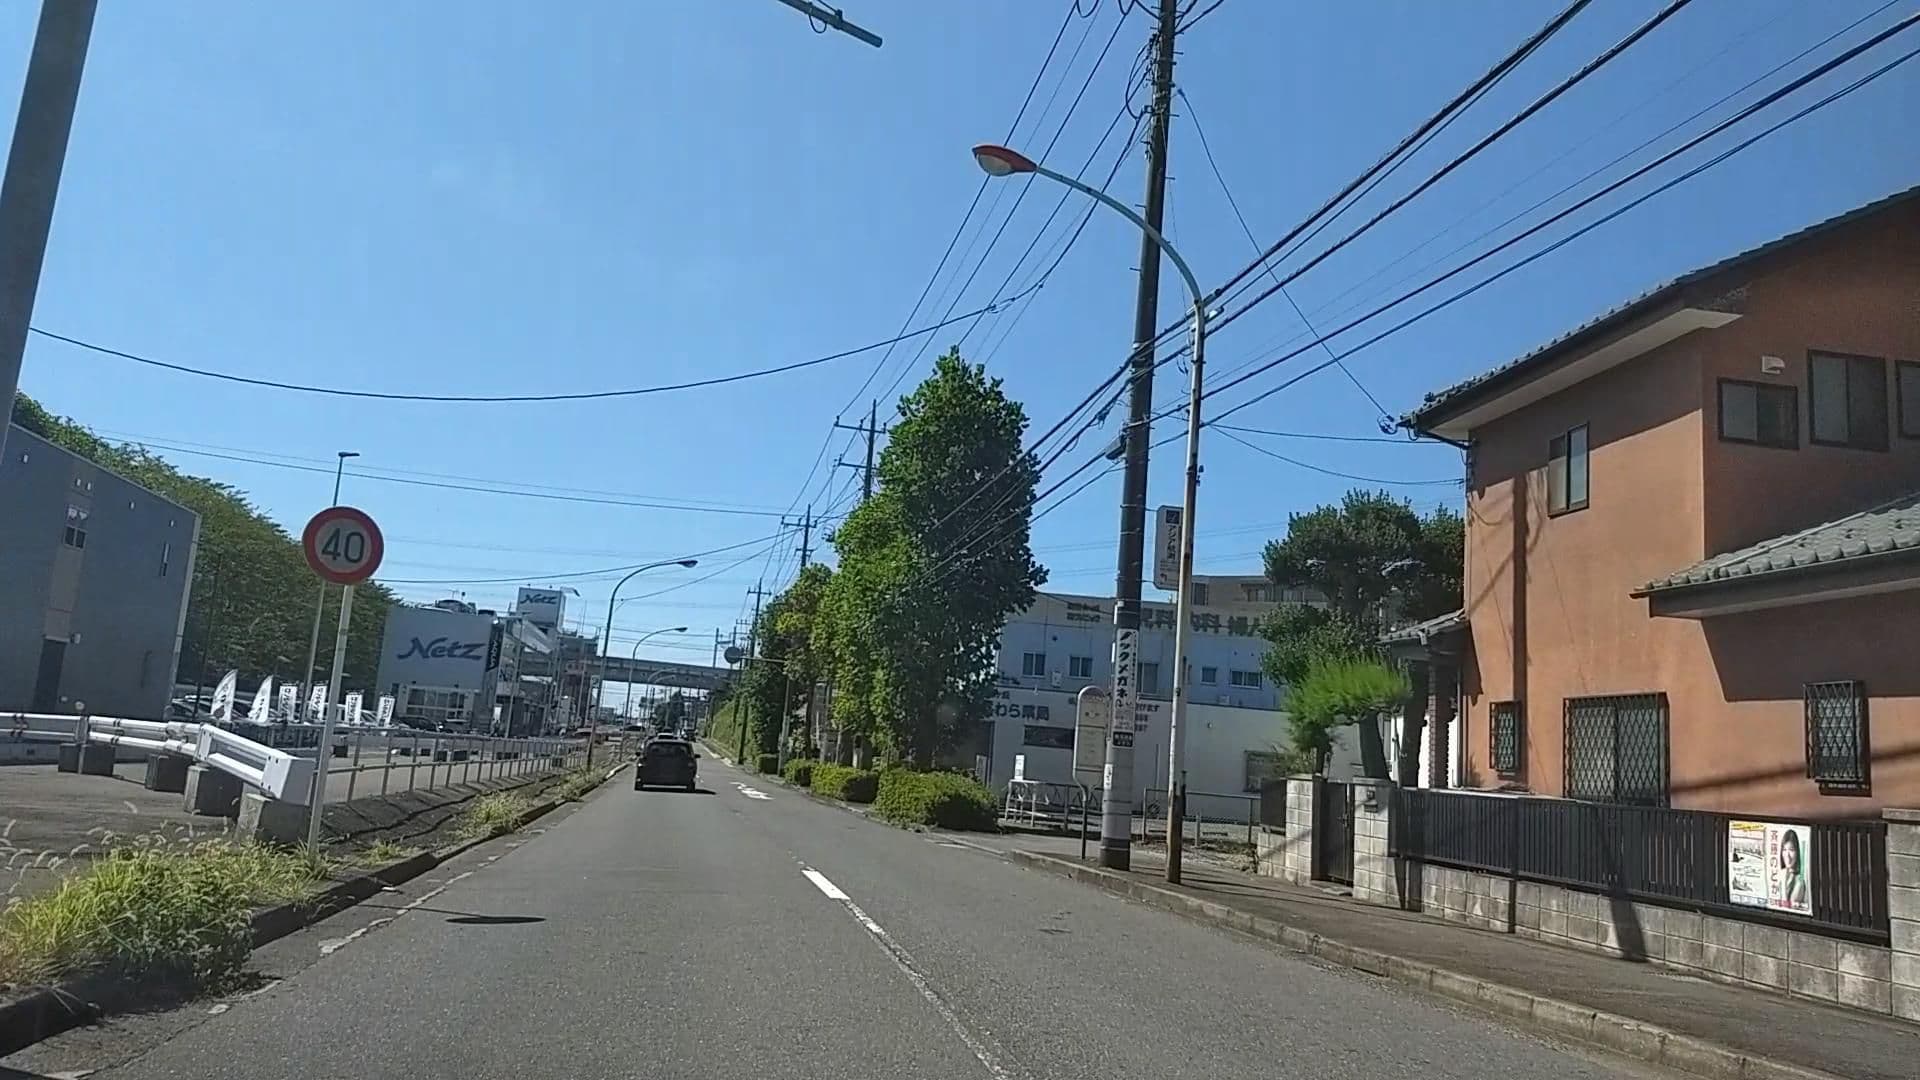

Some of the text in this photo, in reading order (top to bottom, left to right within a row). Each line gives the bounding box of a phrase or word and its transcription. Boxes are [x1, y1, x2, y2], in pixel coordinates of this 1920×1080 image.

[321, 527, 365, 563] 40
[520, 593, 558, 605] Netz
[396, 637, 487, 660] Netz
